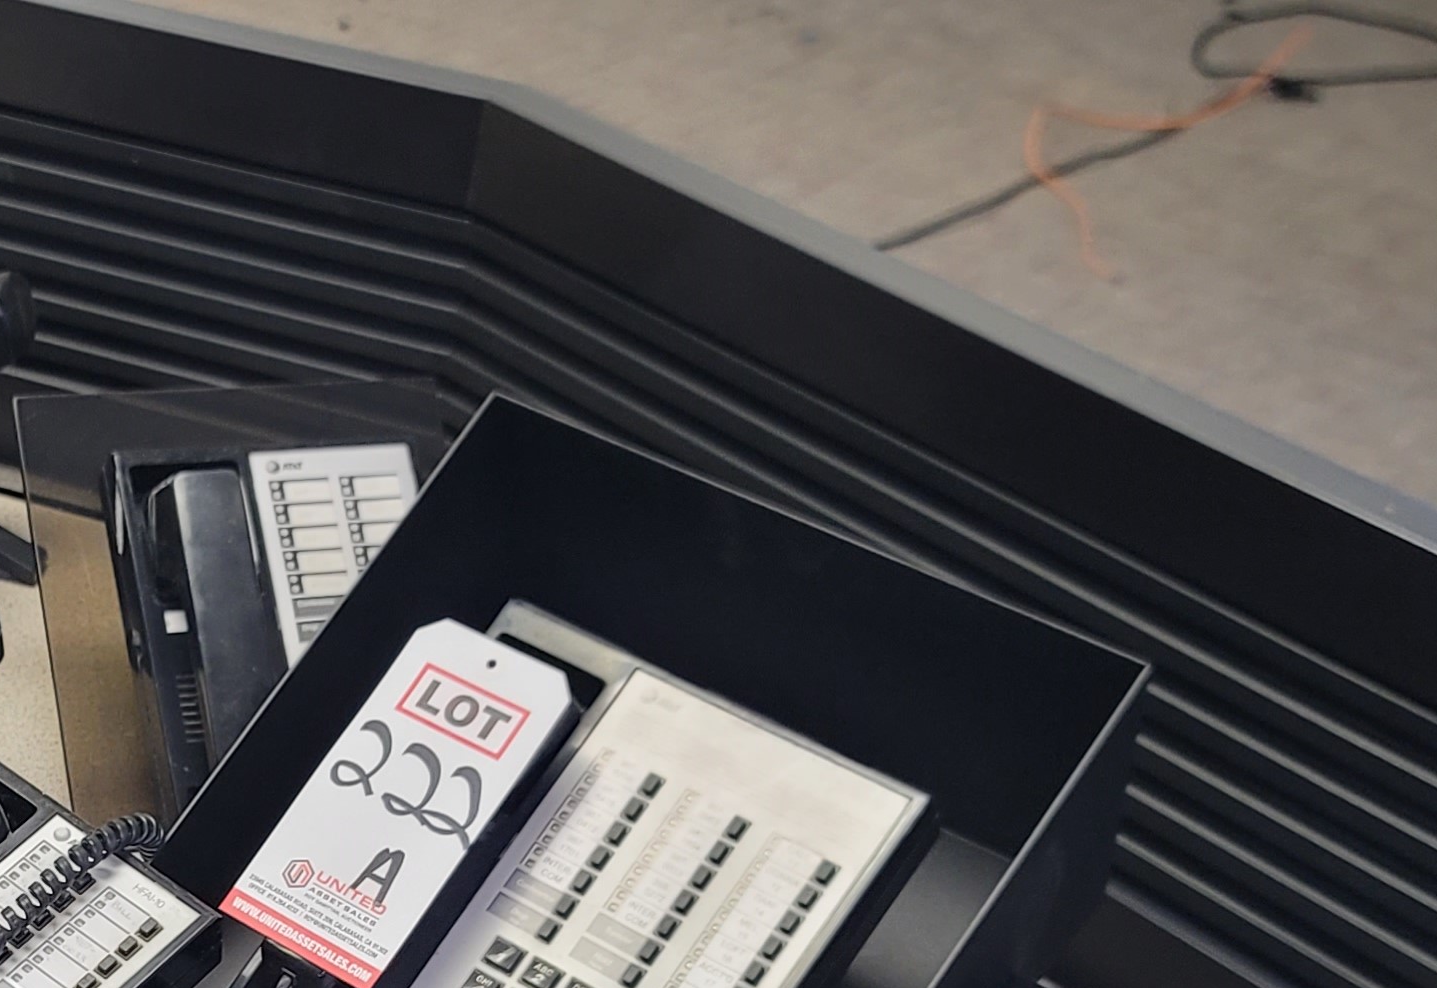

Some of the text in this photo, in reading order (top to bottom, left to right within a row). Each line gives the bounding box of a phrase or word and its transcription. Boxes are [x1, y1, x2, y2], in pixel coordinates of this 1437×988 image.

[415, 680, 512, 740] LOT
[330, 720, 482, 850] 222
[349, 848, 405, 907] A
[541, 868, 563, 885] COM
[543, 856, 571, 876] INTER
[264, 882, 293, 901] CALABASAS
[309, 887, 377, 927] ASSET SALES
[316, 871, 387, 915] UNITED
[232, 897, 372, 982] WWW.UNITEDASSETSALES.COM
[532, 974, 544, 984] 2
[534, 962, 554, 976] ABC
